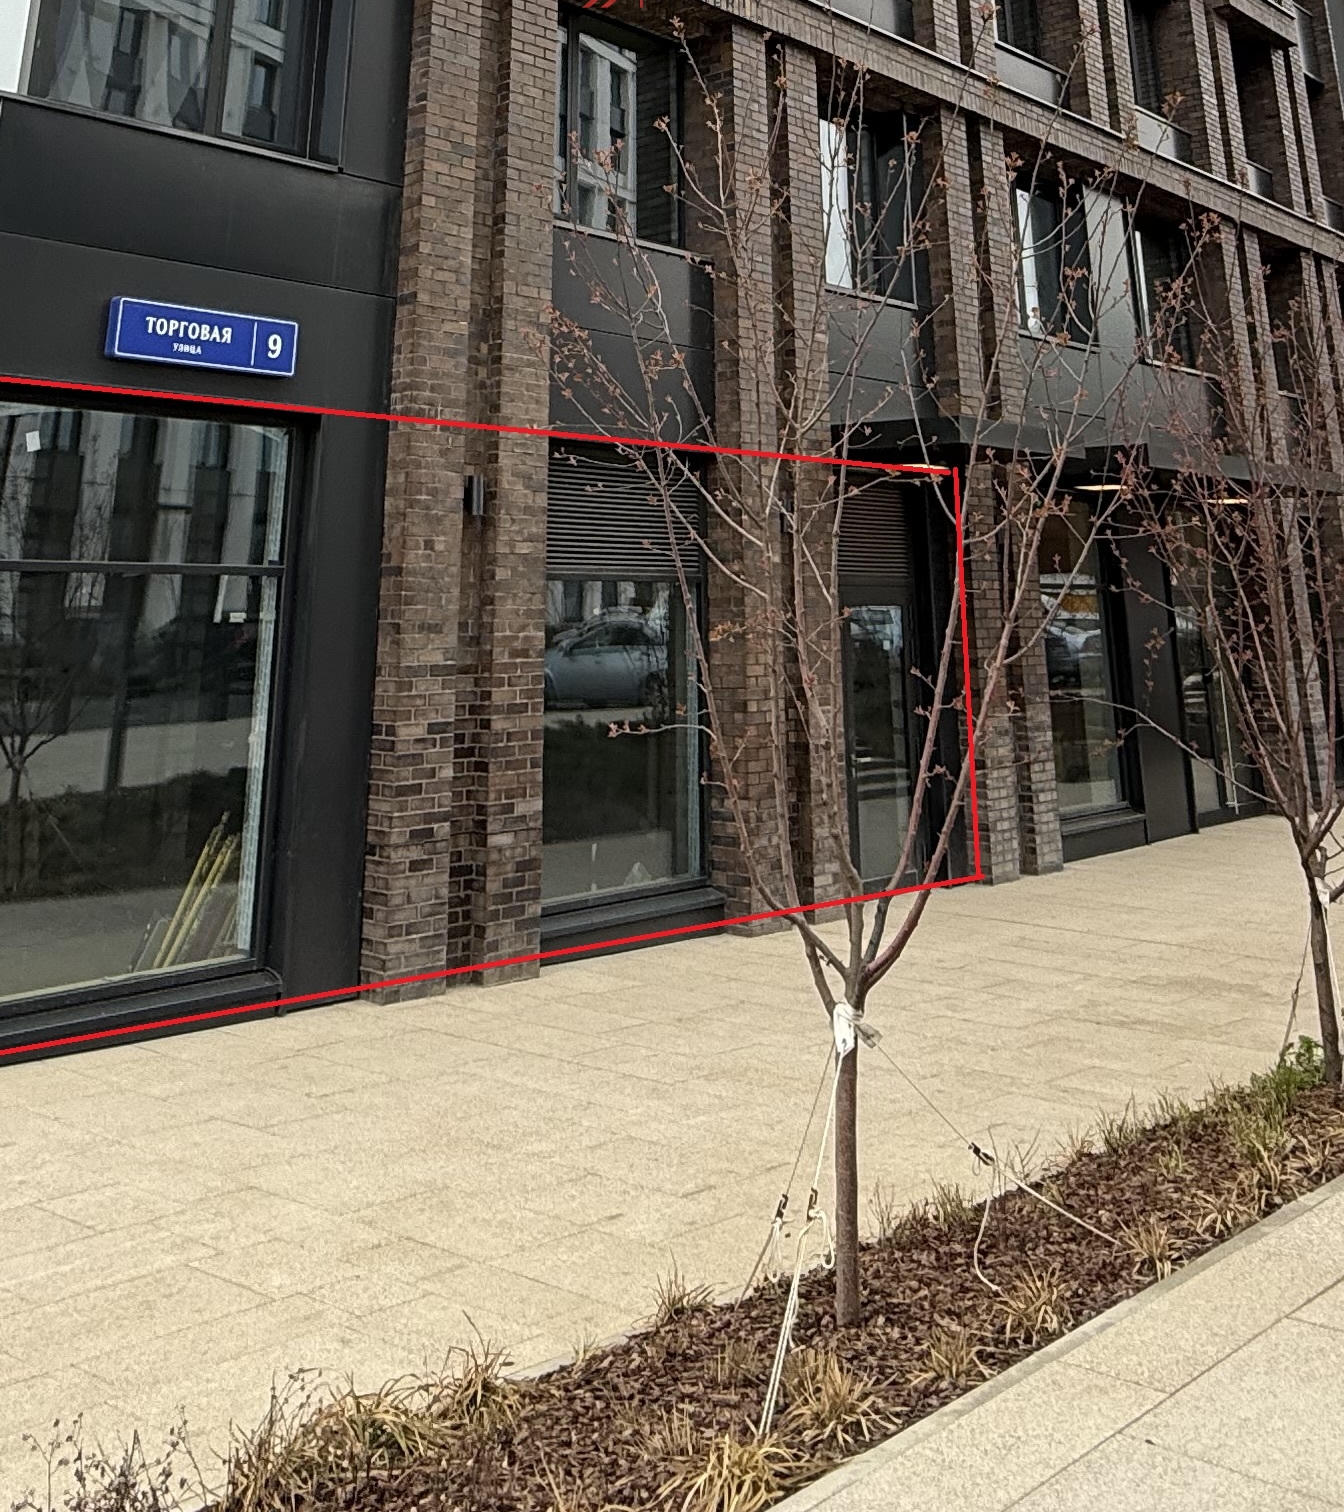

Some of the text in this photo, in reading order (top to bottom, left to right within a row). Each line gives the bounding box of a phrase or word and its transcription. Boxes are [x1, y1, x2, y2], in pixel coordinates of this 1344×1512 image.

[145, 316, 232, 344] ТОРГОВАЯ
[172, 342, 202, 355] УЛИЦА
[267, 334, 282, 359] 9
